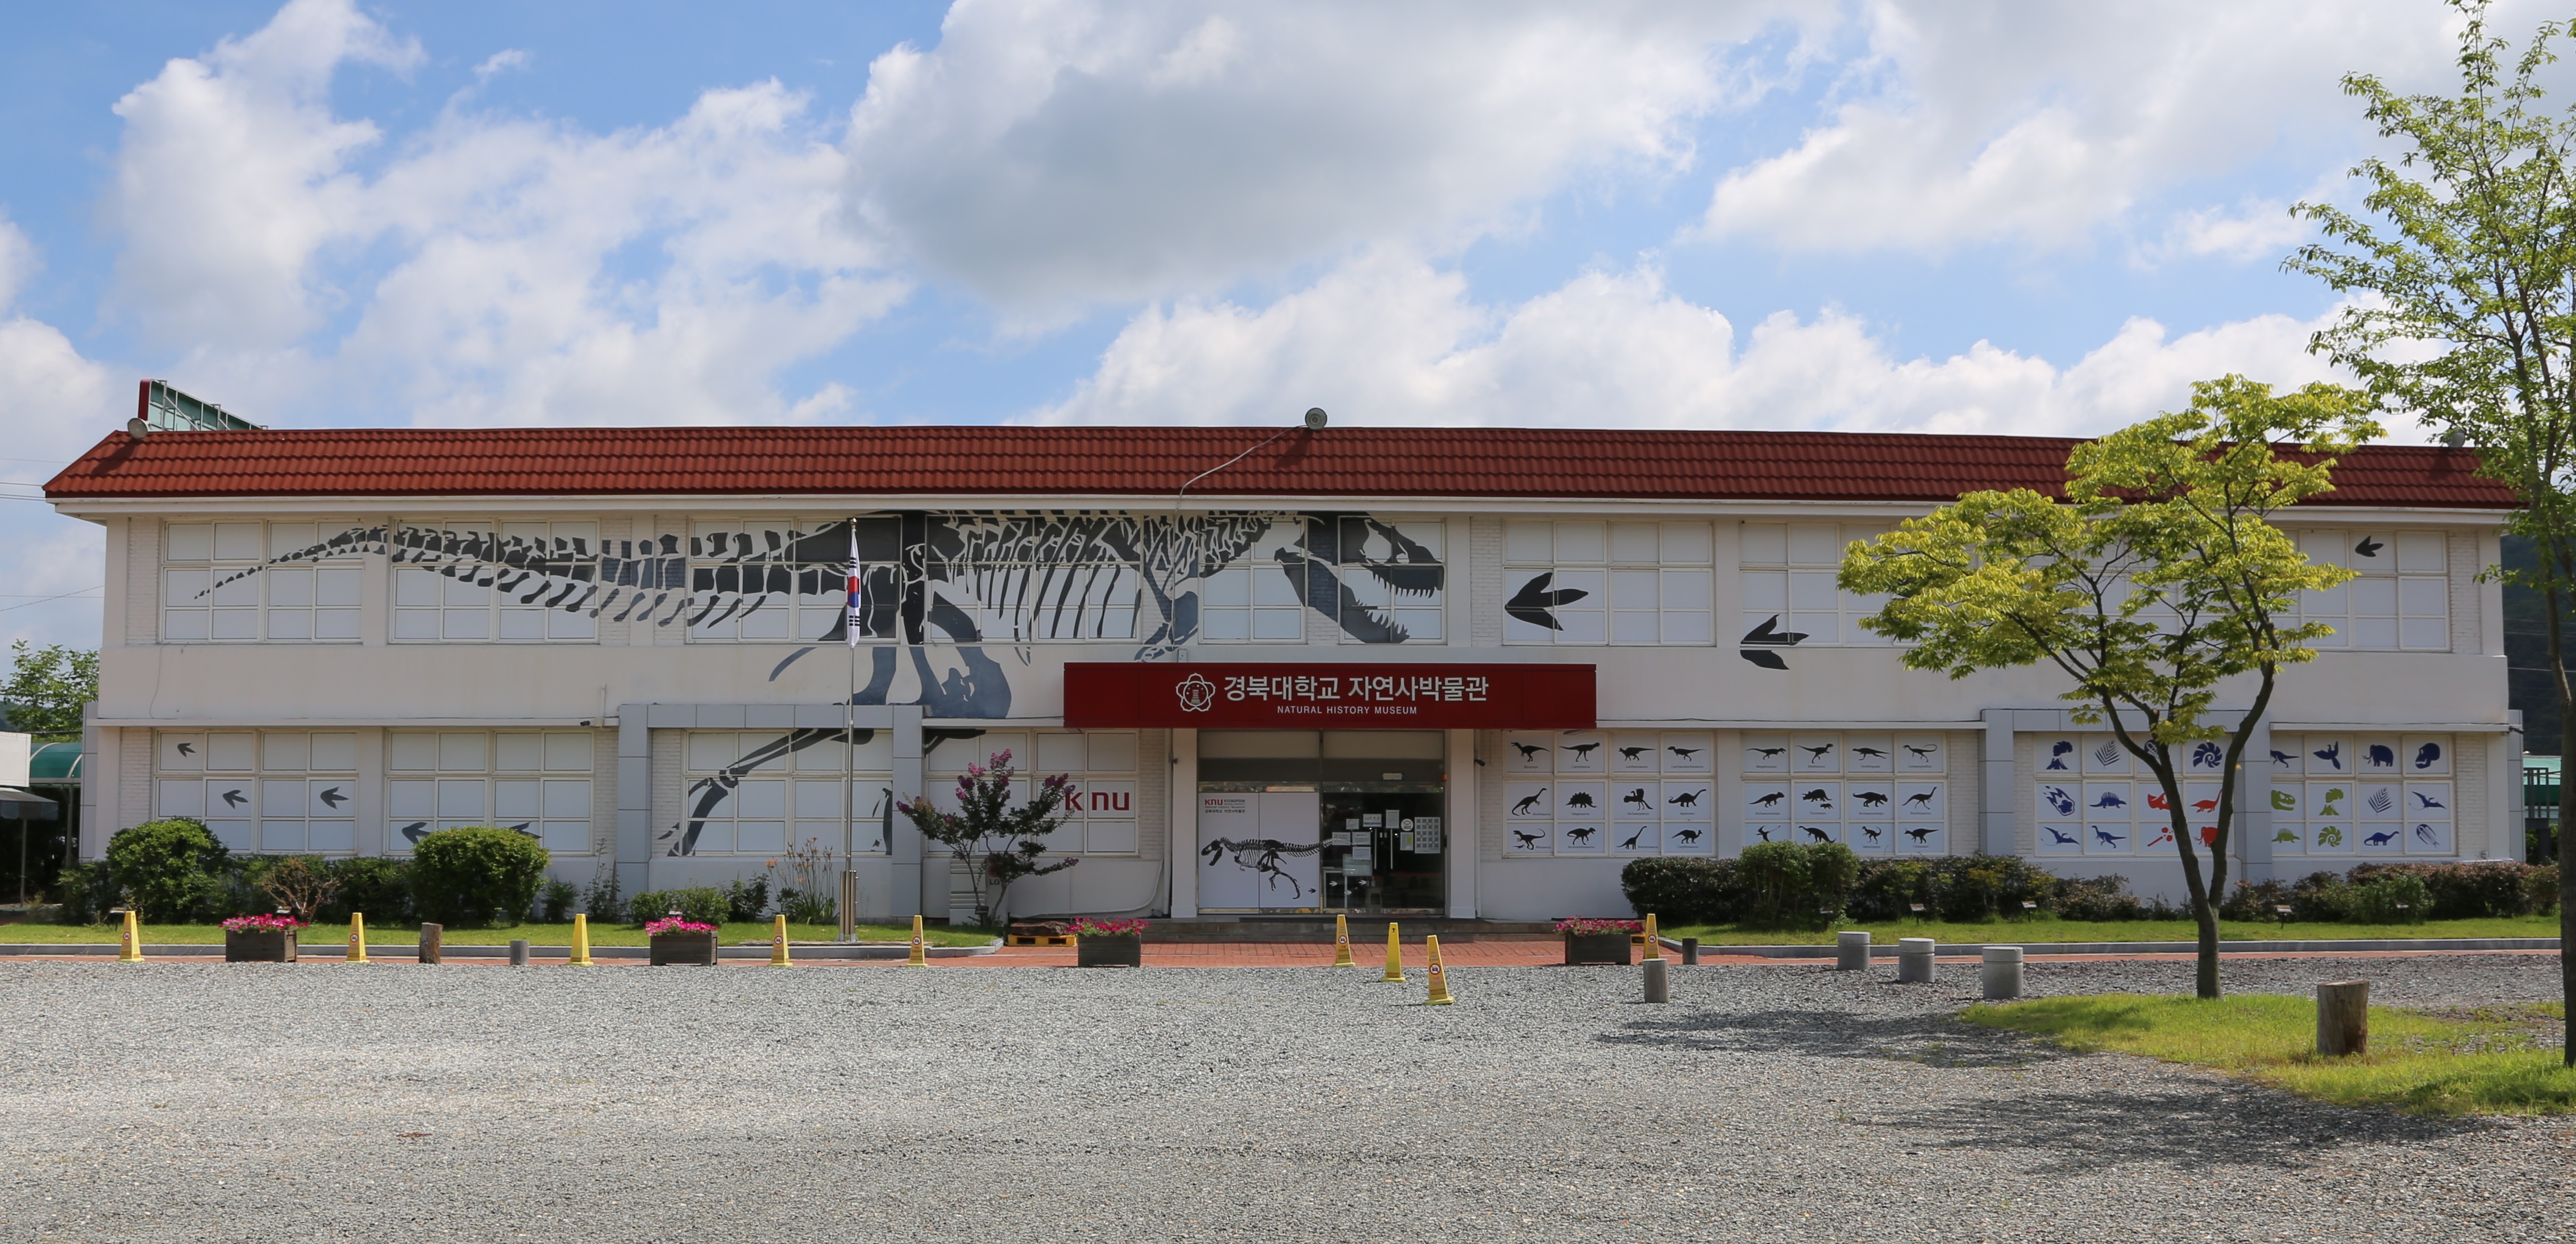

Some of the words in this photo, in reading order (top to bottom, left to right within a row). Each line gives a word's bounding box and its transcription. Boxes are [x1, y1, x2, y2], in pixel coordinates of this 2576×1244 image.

[1224, 676, 1340, 701] 경북대학교
[1348, 676, 1489, 701] 자연사박물관
[1327, 706, 1369, 714] HISTORY
[1374, 706, 1417, 714] MUSEUM
